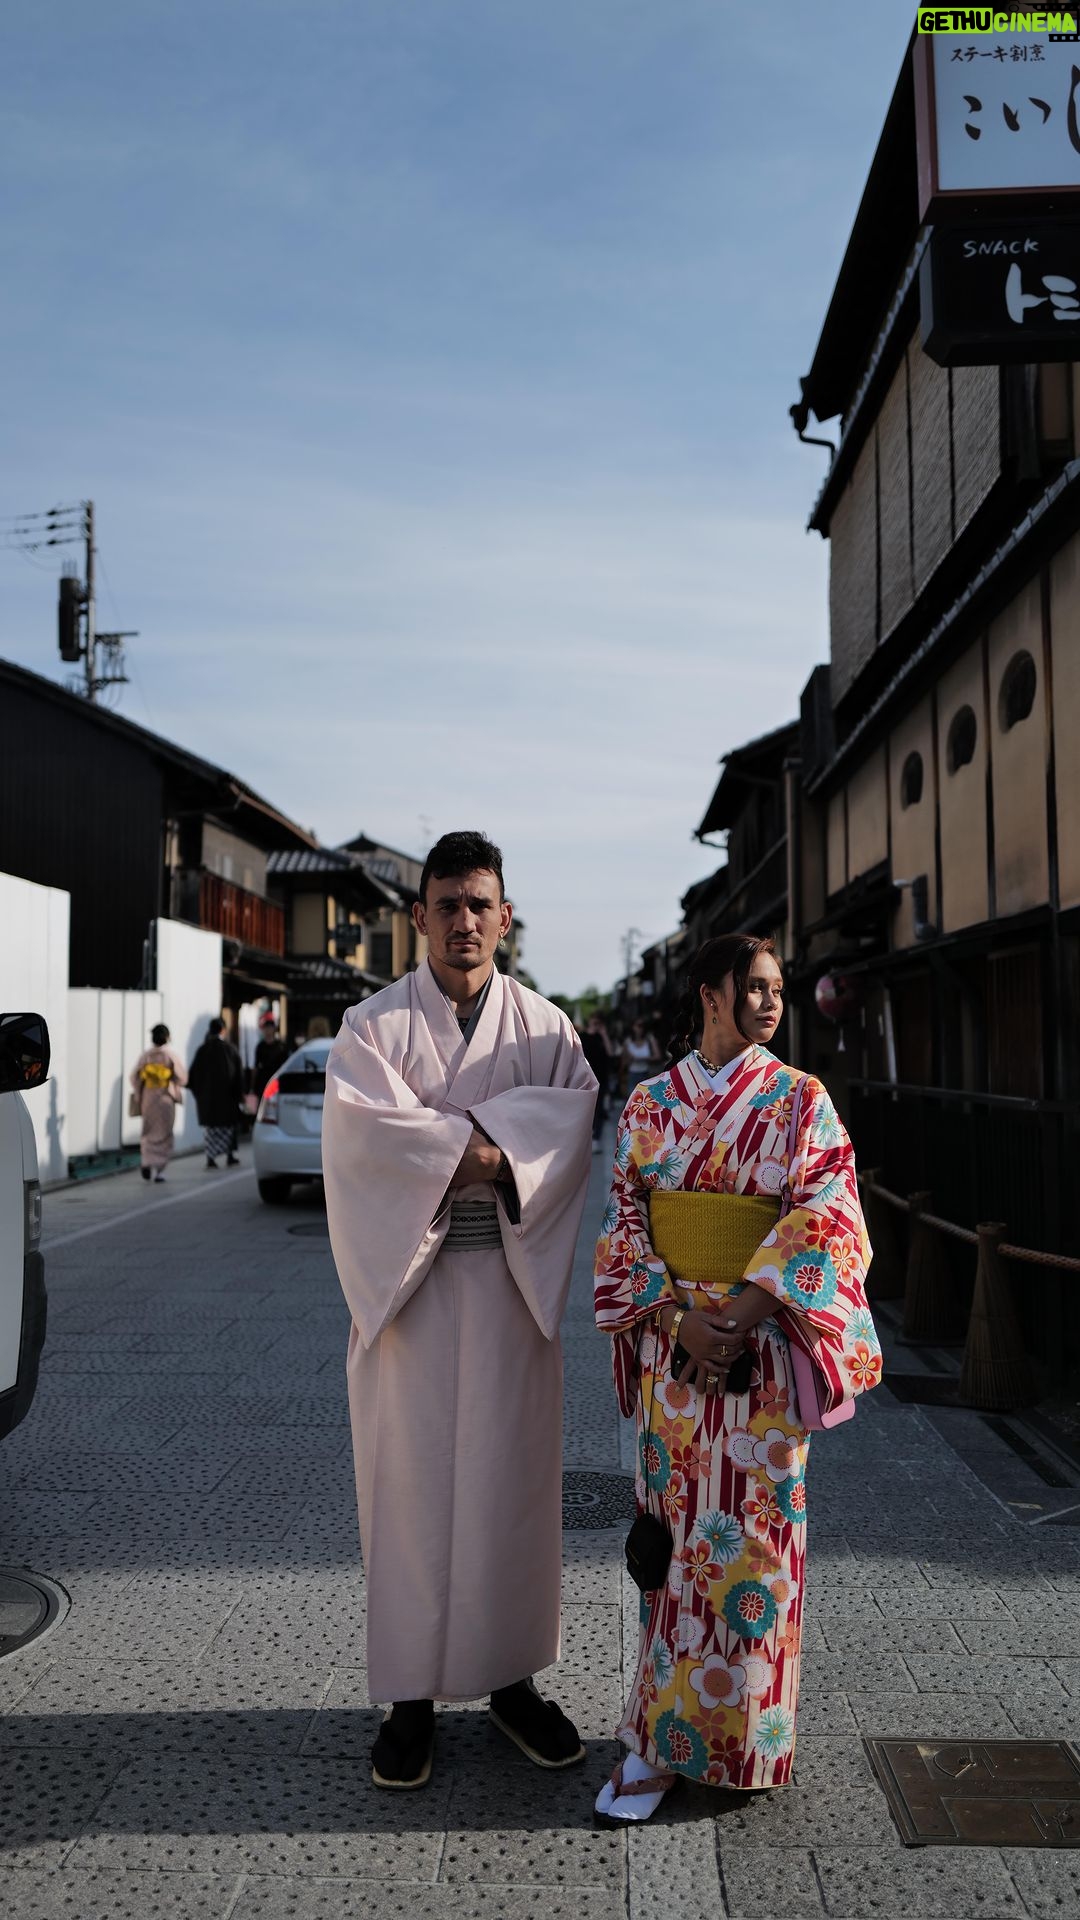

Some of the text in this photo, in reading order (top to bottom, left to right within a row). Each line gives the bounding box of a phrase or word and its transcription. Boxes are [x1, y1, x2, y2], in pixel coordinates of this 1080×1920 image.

[951, 44, 1046, 63] ステーキ割烹
[962, 237, 1040, 259] SNACK
